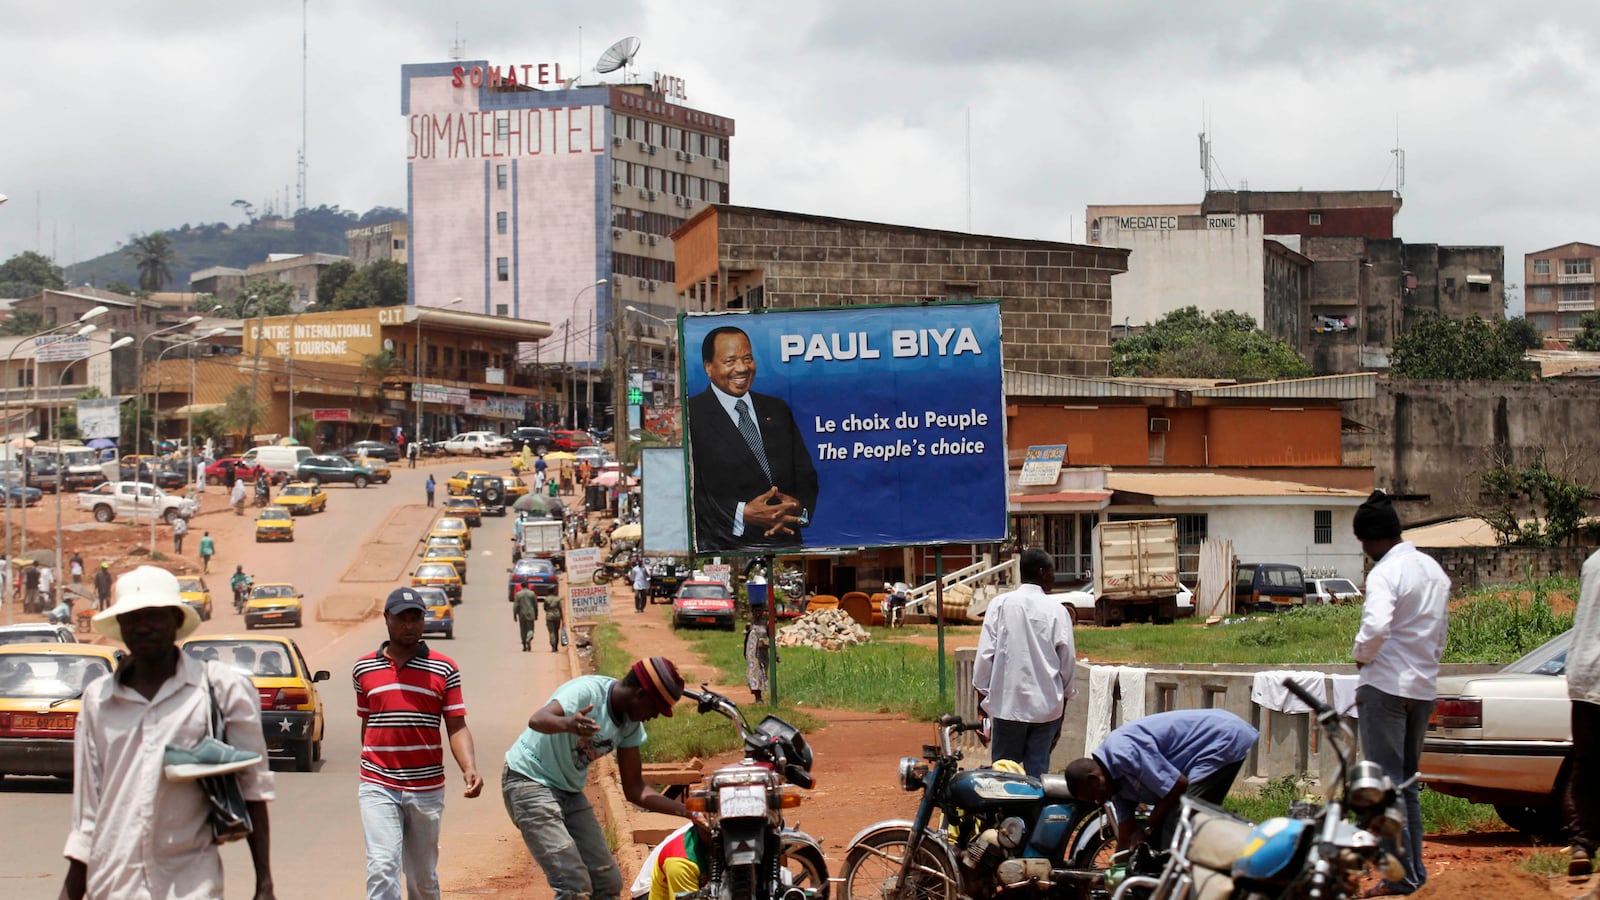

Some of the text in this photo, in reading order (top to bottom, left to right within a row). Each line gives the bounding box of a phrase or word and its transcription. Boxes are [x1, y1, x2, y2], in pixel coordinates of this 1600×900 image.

[452, 63, 566, 89] SOMATEL
[654, 71, 687, 100] HOTEL
[407, 111, 503, 160] SOMATEL
[507, 105, 604, 157] HOTEL
[1120, 216, 1176, 229] MEGATEC
[294, 323, 373, 339] INTERNATIONAL
[276, 341, 347, 355] DE TOURISME
[780, 327, 982, 362] PAUL BIYA
[815, 408, 988, 433] Le choix du Peuple
[817, 437, 985, 462] The People's choice
[572, 595, 607, 607] PEINTURE
